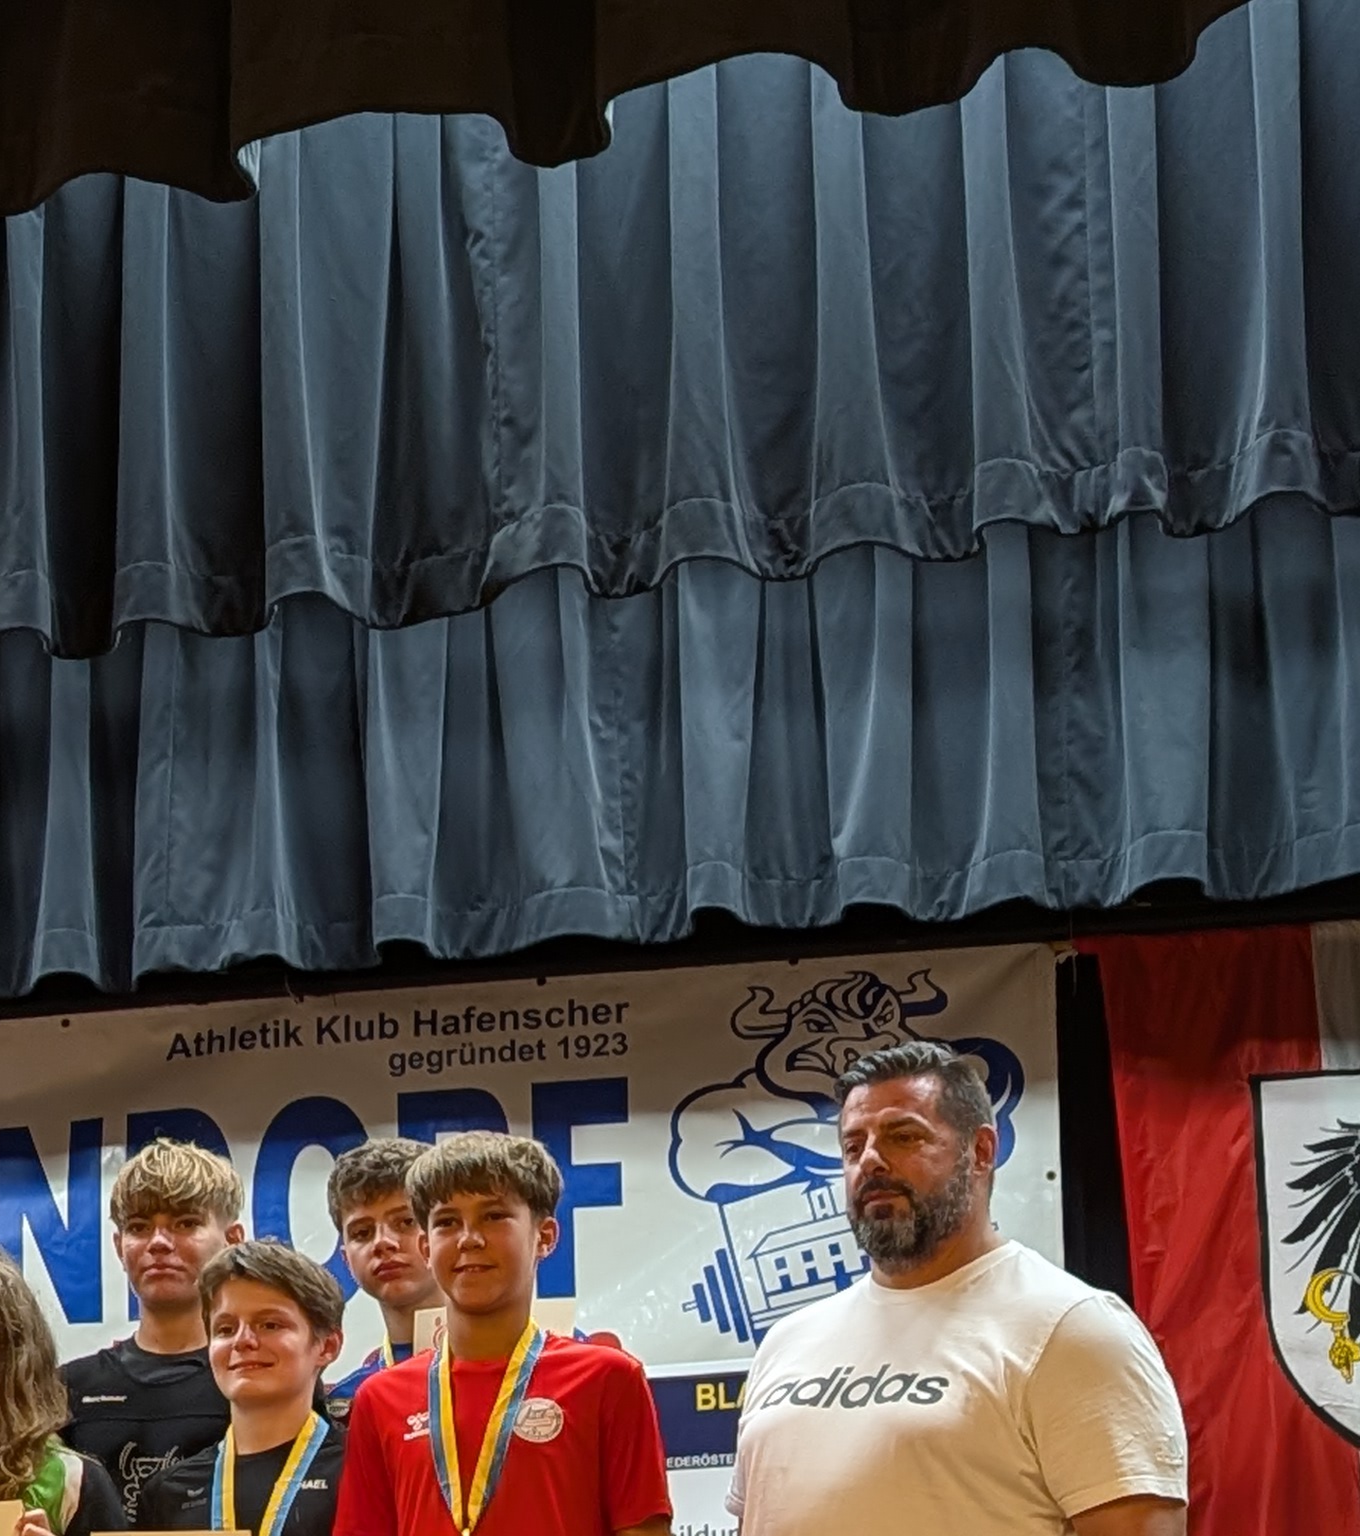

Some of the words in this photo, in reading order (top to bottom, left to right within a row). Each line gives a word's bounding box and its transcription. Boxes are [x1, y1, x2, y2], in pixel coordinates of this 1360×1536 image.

[165, 1020, 303, 1063] Athletik
[316, 1011, 401, 1045] Klub
[412, 999, 630, 1039] Hafenscher
[387, 1038, 547, 1077] gegründet
[557, 1033, 630, 1061] 1923
[760, 1364, 949, 1410] adidas
